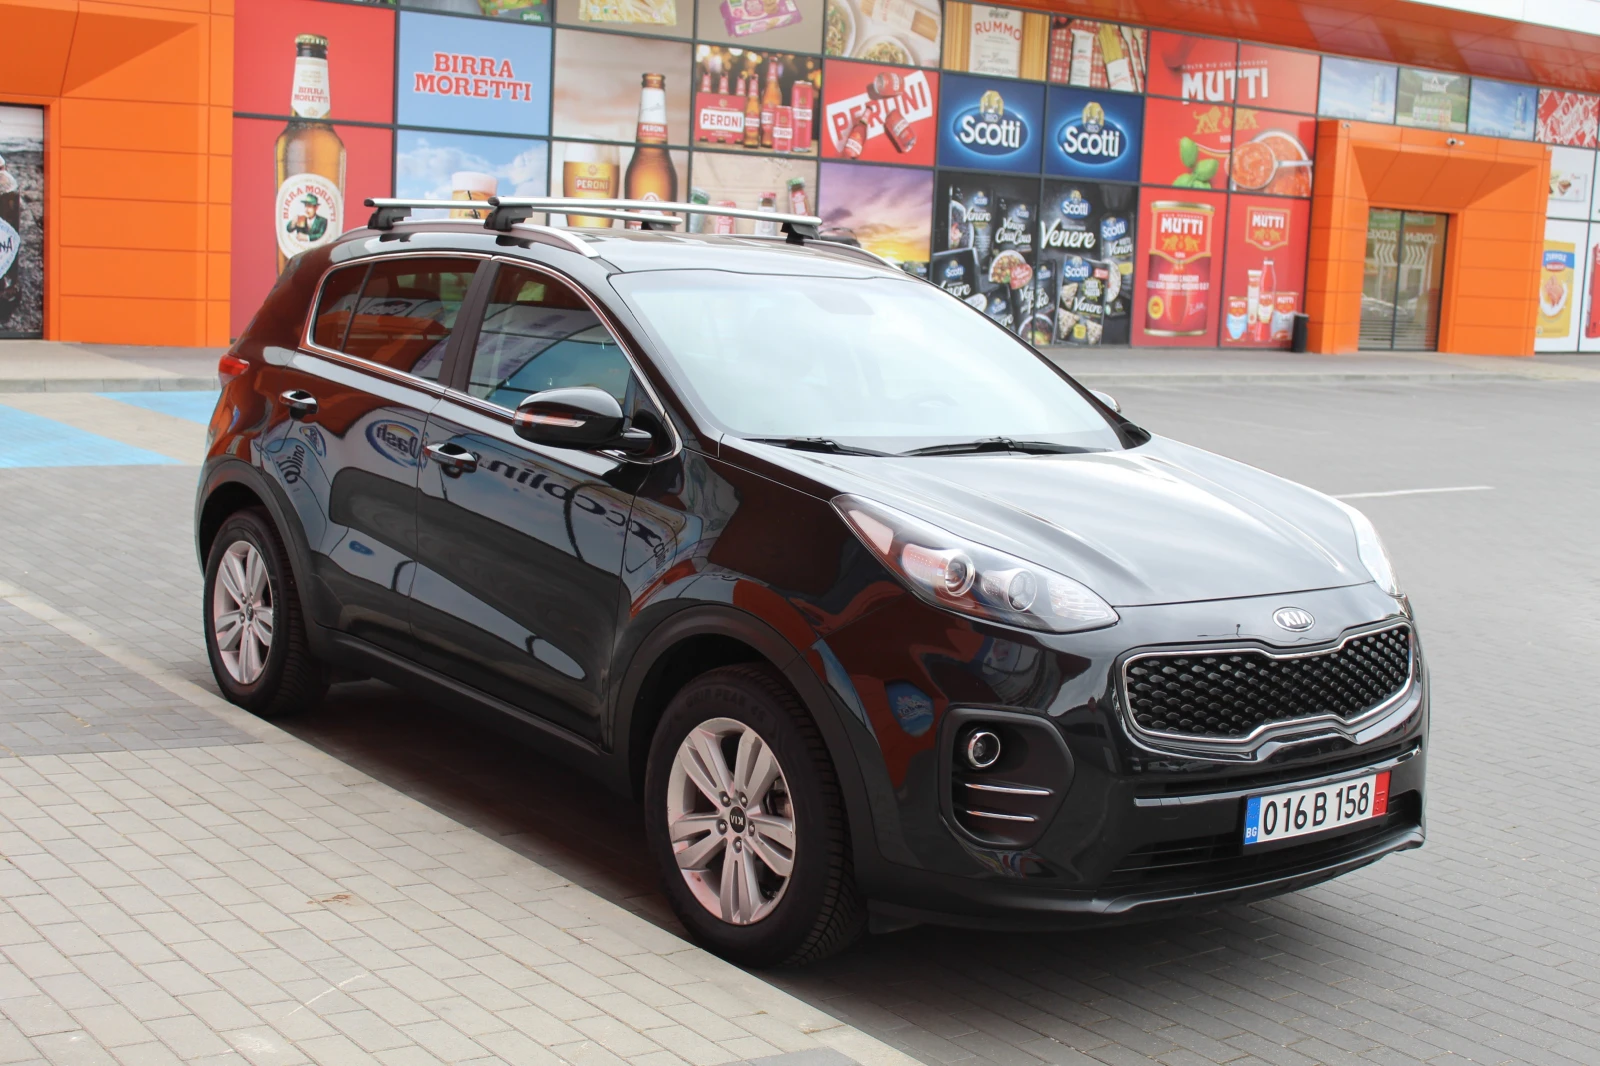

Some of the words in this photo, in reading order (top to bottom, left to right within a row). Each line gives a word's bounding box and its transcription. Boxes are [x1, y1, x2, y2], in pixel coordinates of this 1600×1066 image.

[975, 21, 1022, 41] RUMMO
[434, 52, 514, 79] BIRRA
[299, 86, 325, 95] BIRRA
[414, 73, 532, 101] MORETTI
[1182, 67, 1269, 104] MUTTI
[703, 113, 742, 127] PERONI
[960, 115, 1021, 148] Scotti
[1064, 126, 1120, 157] Scotti
[576, 180, 608, 190] PERONI
[283, 188, 303, 219] BIRRA
[305, 185, 337, 222] MORETTI
[1063, 202, 1089, 216] Scotti
[964, 207, 991, 222] Venere
[1252, 214, 1285, 229] MUTTI
[1040, 218, 1096, 249] Venere
[1102, 221, 1126, 238] Scotti
[1161, 217, 1204, 235] MUTTI
[946, 267, 964, 277] Scotti
[1065, 266, 1089, 278] Scotti
[1281, 610, 1311, 626] KIA
[1263, 795, 1308, 836] 016
[1312, 791, 1327, 826] B
[1336, 782, 1370, 821] 158
[730, 814, 744, 826] KIA
[1246, 826, 1257, 838] BG
